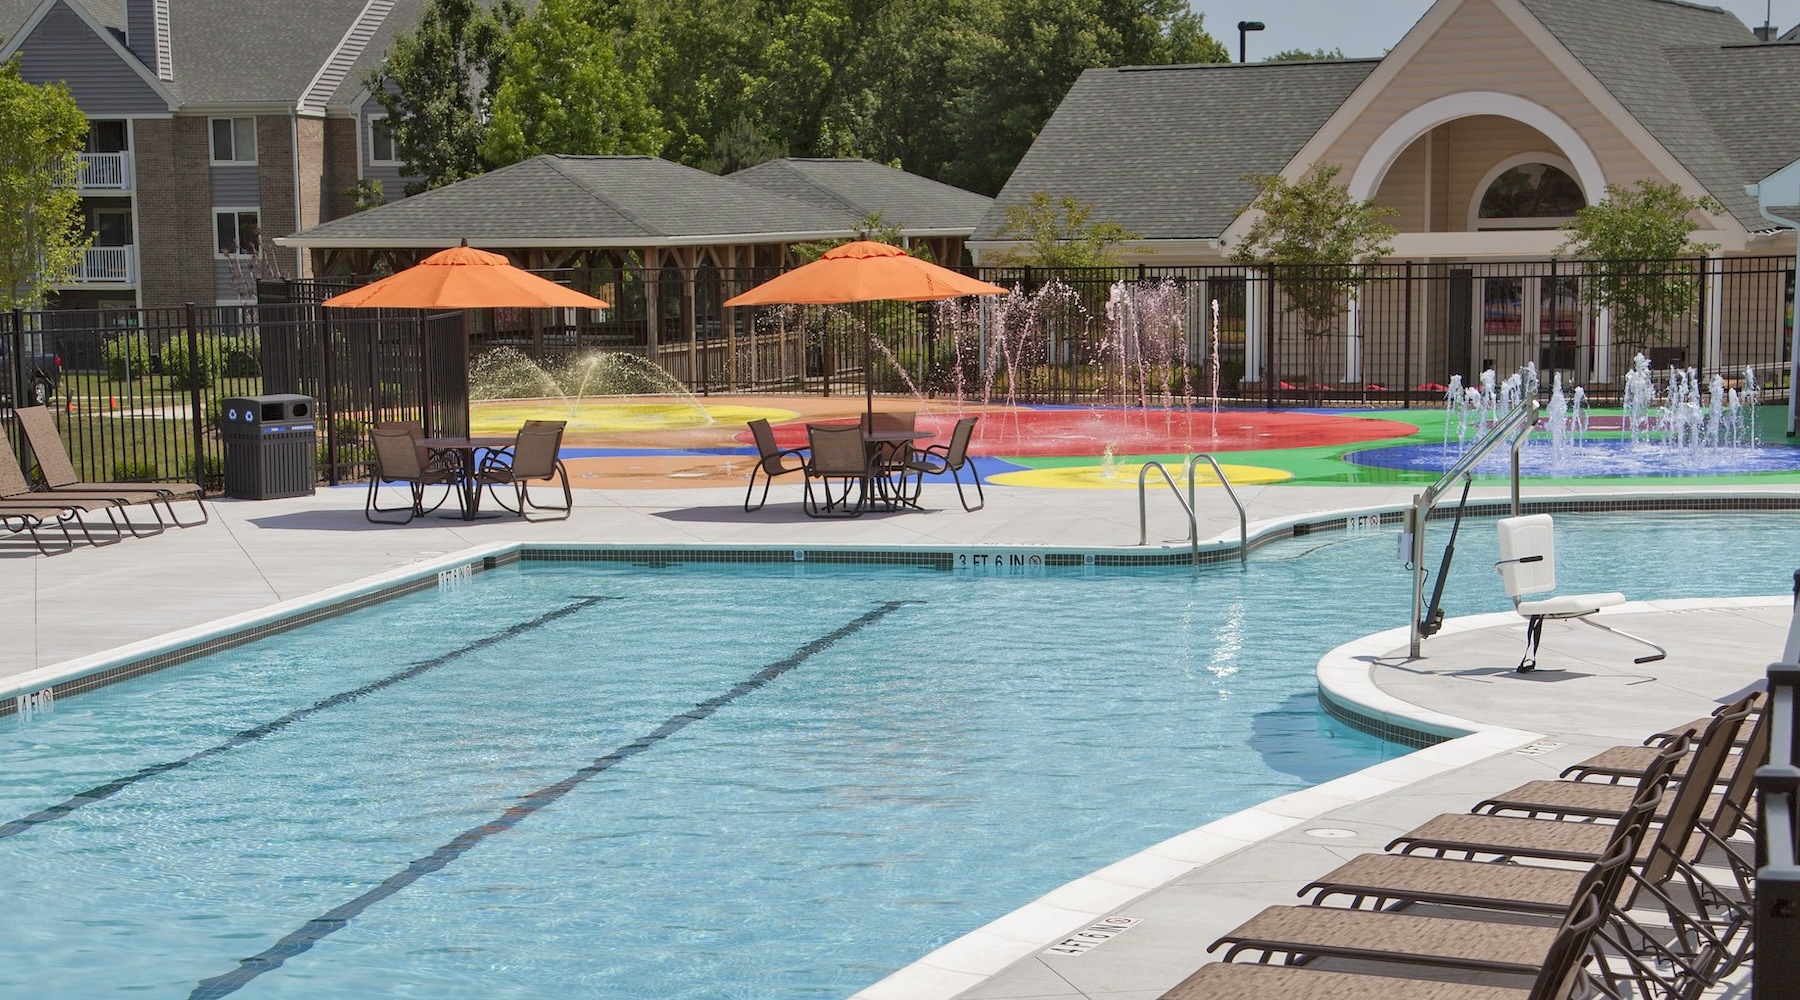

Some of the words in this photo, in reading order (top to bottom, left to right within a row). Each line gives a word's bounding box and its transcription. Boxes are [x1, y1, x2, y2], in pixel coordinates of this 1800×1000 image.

[1358, 516, 1368, 529] FT
[959, 554, 967, 566] 3
[973, 554, 989, 566] FT
[995, 554, 1003, 566] 6
[1009, 554, 1024, 566] IN
[30, 691, 40, 708] FT
[1059, 938, 1099, 948] FT
[1087, 923, 1128, 933] IN
